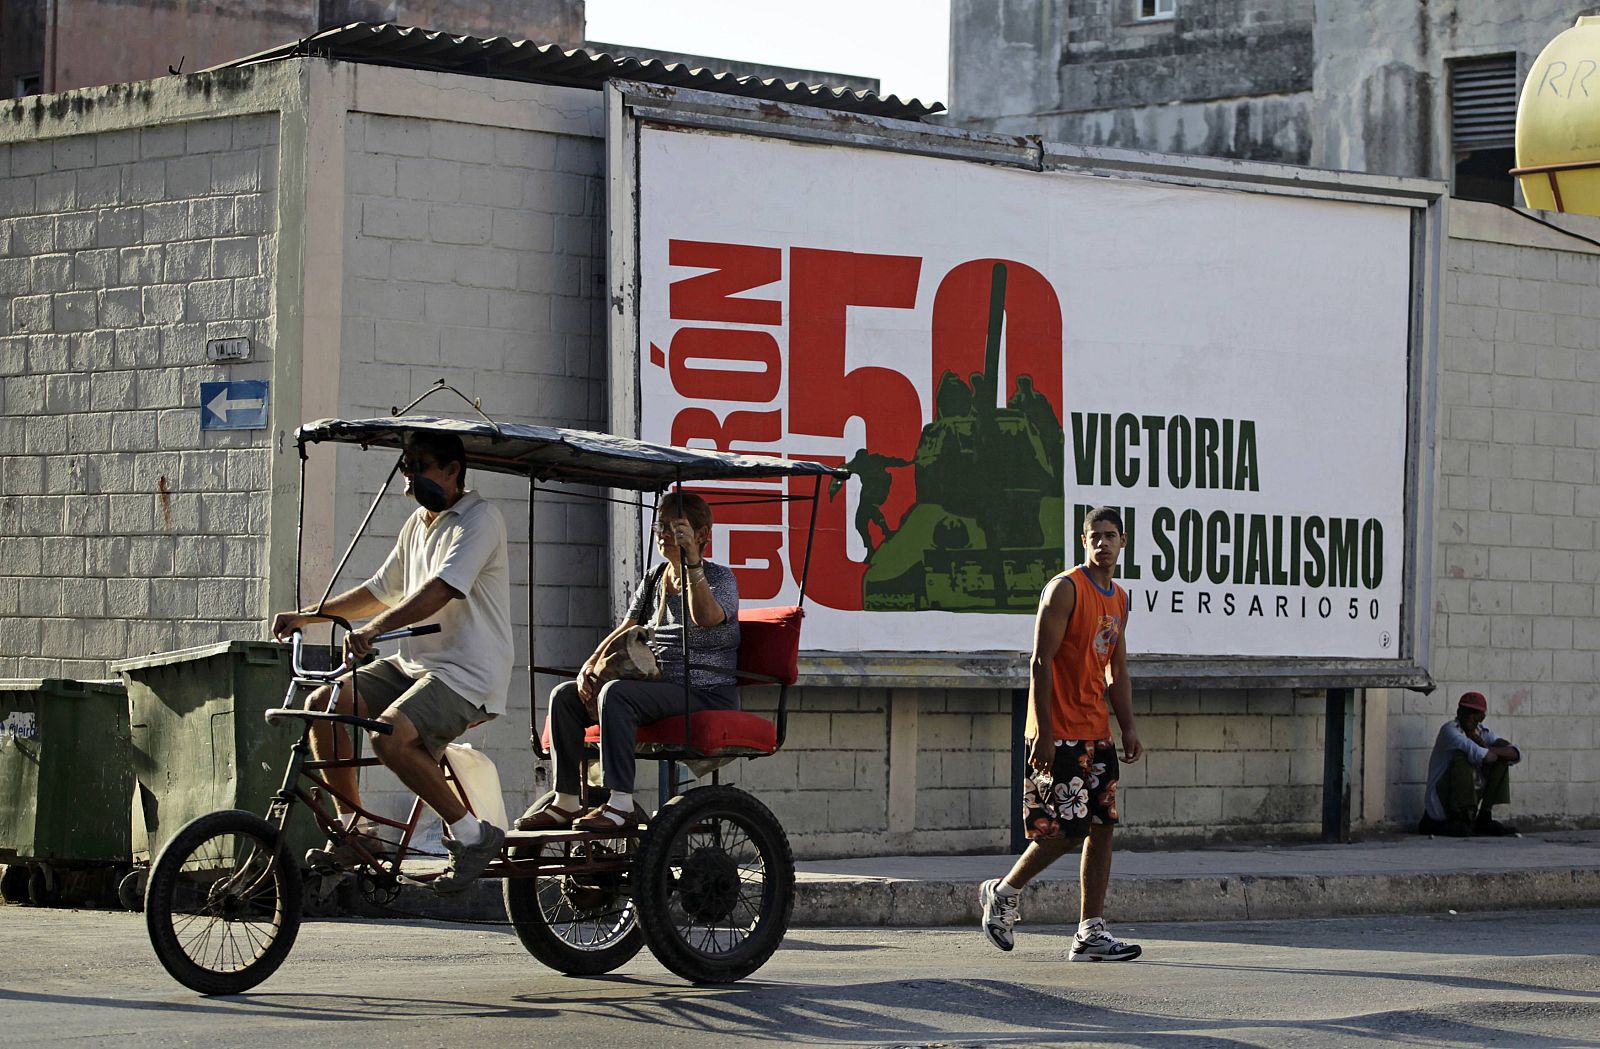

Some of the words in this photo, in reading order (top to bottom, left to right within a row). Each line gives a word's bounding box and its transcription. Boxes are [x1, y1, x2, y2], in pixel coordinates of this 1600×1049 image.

[650, 239, 784, 600] GRÓN
[788, 246, 1064, 612] 50
[1071, 412, 1260, 492] VICTORIA
[1151, 507, 1384, 590] SOCIALISMO
[1127, 589, 1332, 619] IVERSARIO
[1349, 598, 1379, 620] 50
